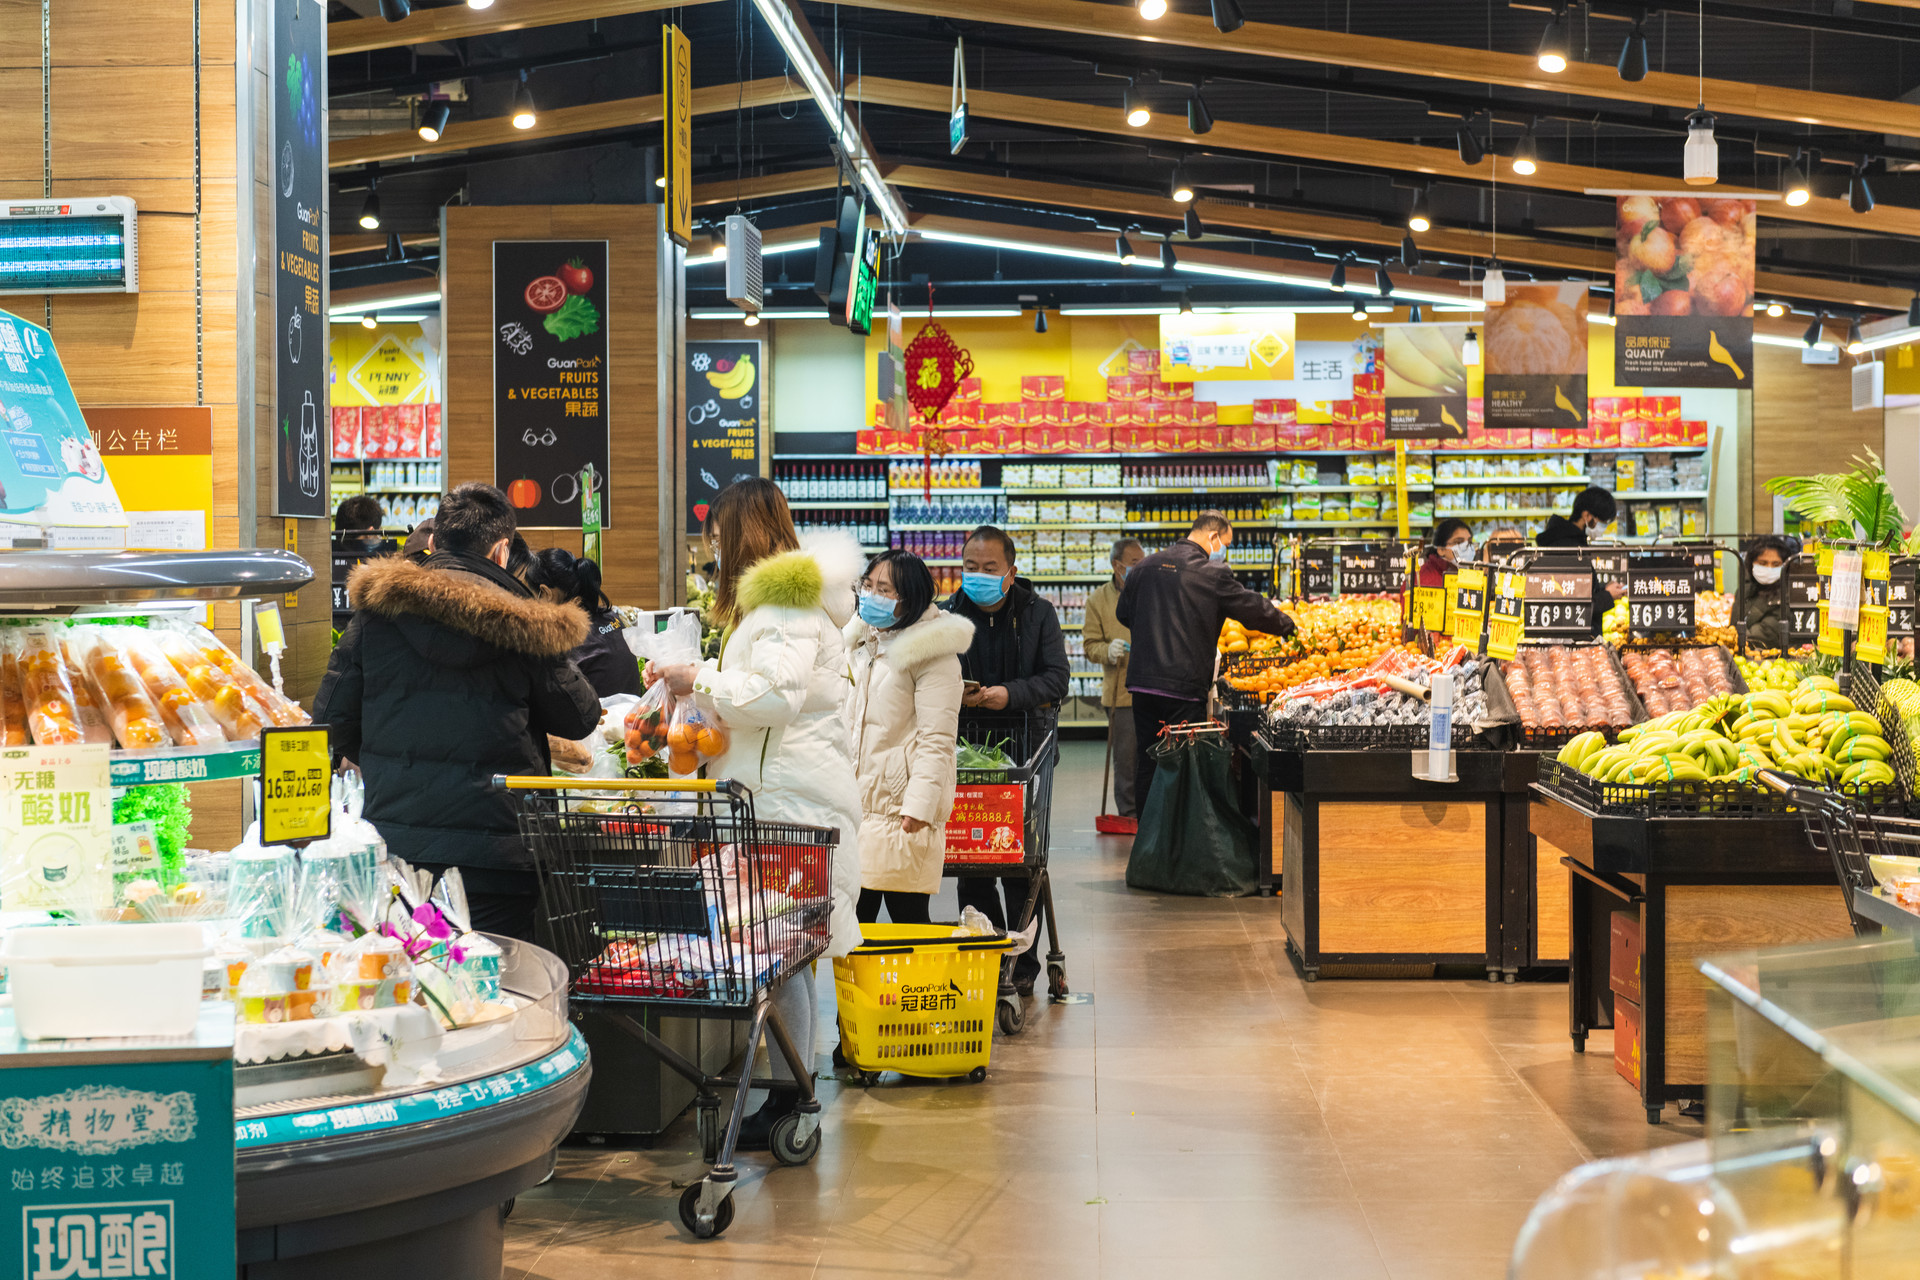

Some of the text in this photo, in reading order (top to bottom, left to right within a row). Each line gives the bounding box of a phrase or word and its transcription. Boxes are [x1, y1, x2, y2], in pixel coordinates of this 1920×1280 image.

[296, 201, 319, 227] GuanPark
[302, 229, 319, 255] FRUITS
[281, 250, 319, 283] & VEGETABLES
[1625, 336, 1671, 349] 品质保证
[1625, 349, 1665, 359] QUALITY
[547, 357, 597, 369] GuanPark
[1302, 360, 1342, 381] 生活
[560, 371, 599, 384] FRUITS
[917, 357, 941, 389] 福
[507, 387, 599, 400] & VEGETABLES
[565, 401, 598, 418] 果蔬
[1491, 400, 1523, 408] HEALTHY
[718, 418, 753, 427] GuanPark
[727, 428, 754, 437] FRUITS
[692, 438, 754, 448] & VEGETABLES
[1541, 579, 1576, 595] 柿饼
[1633, 579, 1691, 595] 热销商品
[143, 758, 208, 781] 现酿酸奶
[14, 770, 56, 791] 无糖
[21, 791, 91, 827] 酸奶
[946, 811, 1015, 824] 减58888元
[901, 983, 948, 994] GuanPark
[901, 993, 957, 1012] 冠超市
[39, 1103, 154, 1138] 精物堂
[11, 1162, 184, 1191] 始终追求卓越
[31, 1211, 168, 1280] 现酿
